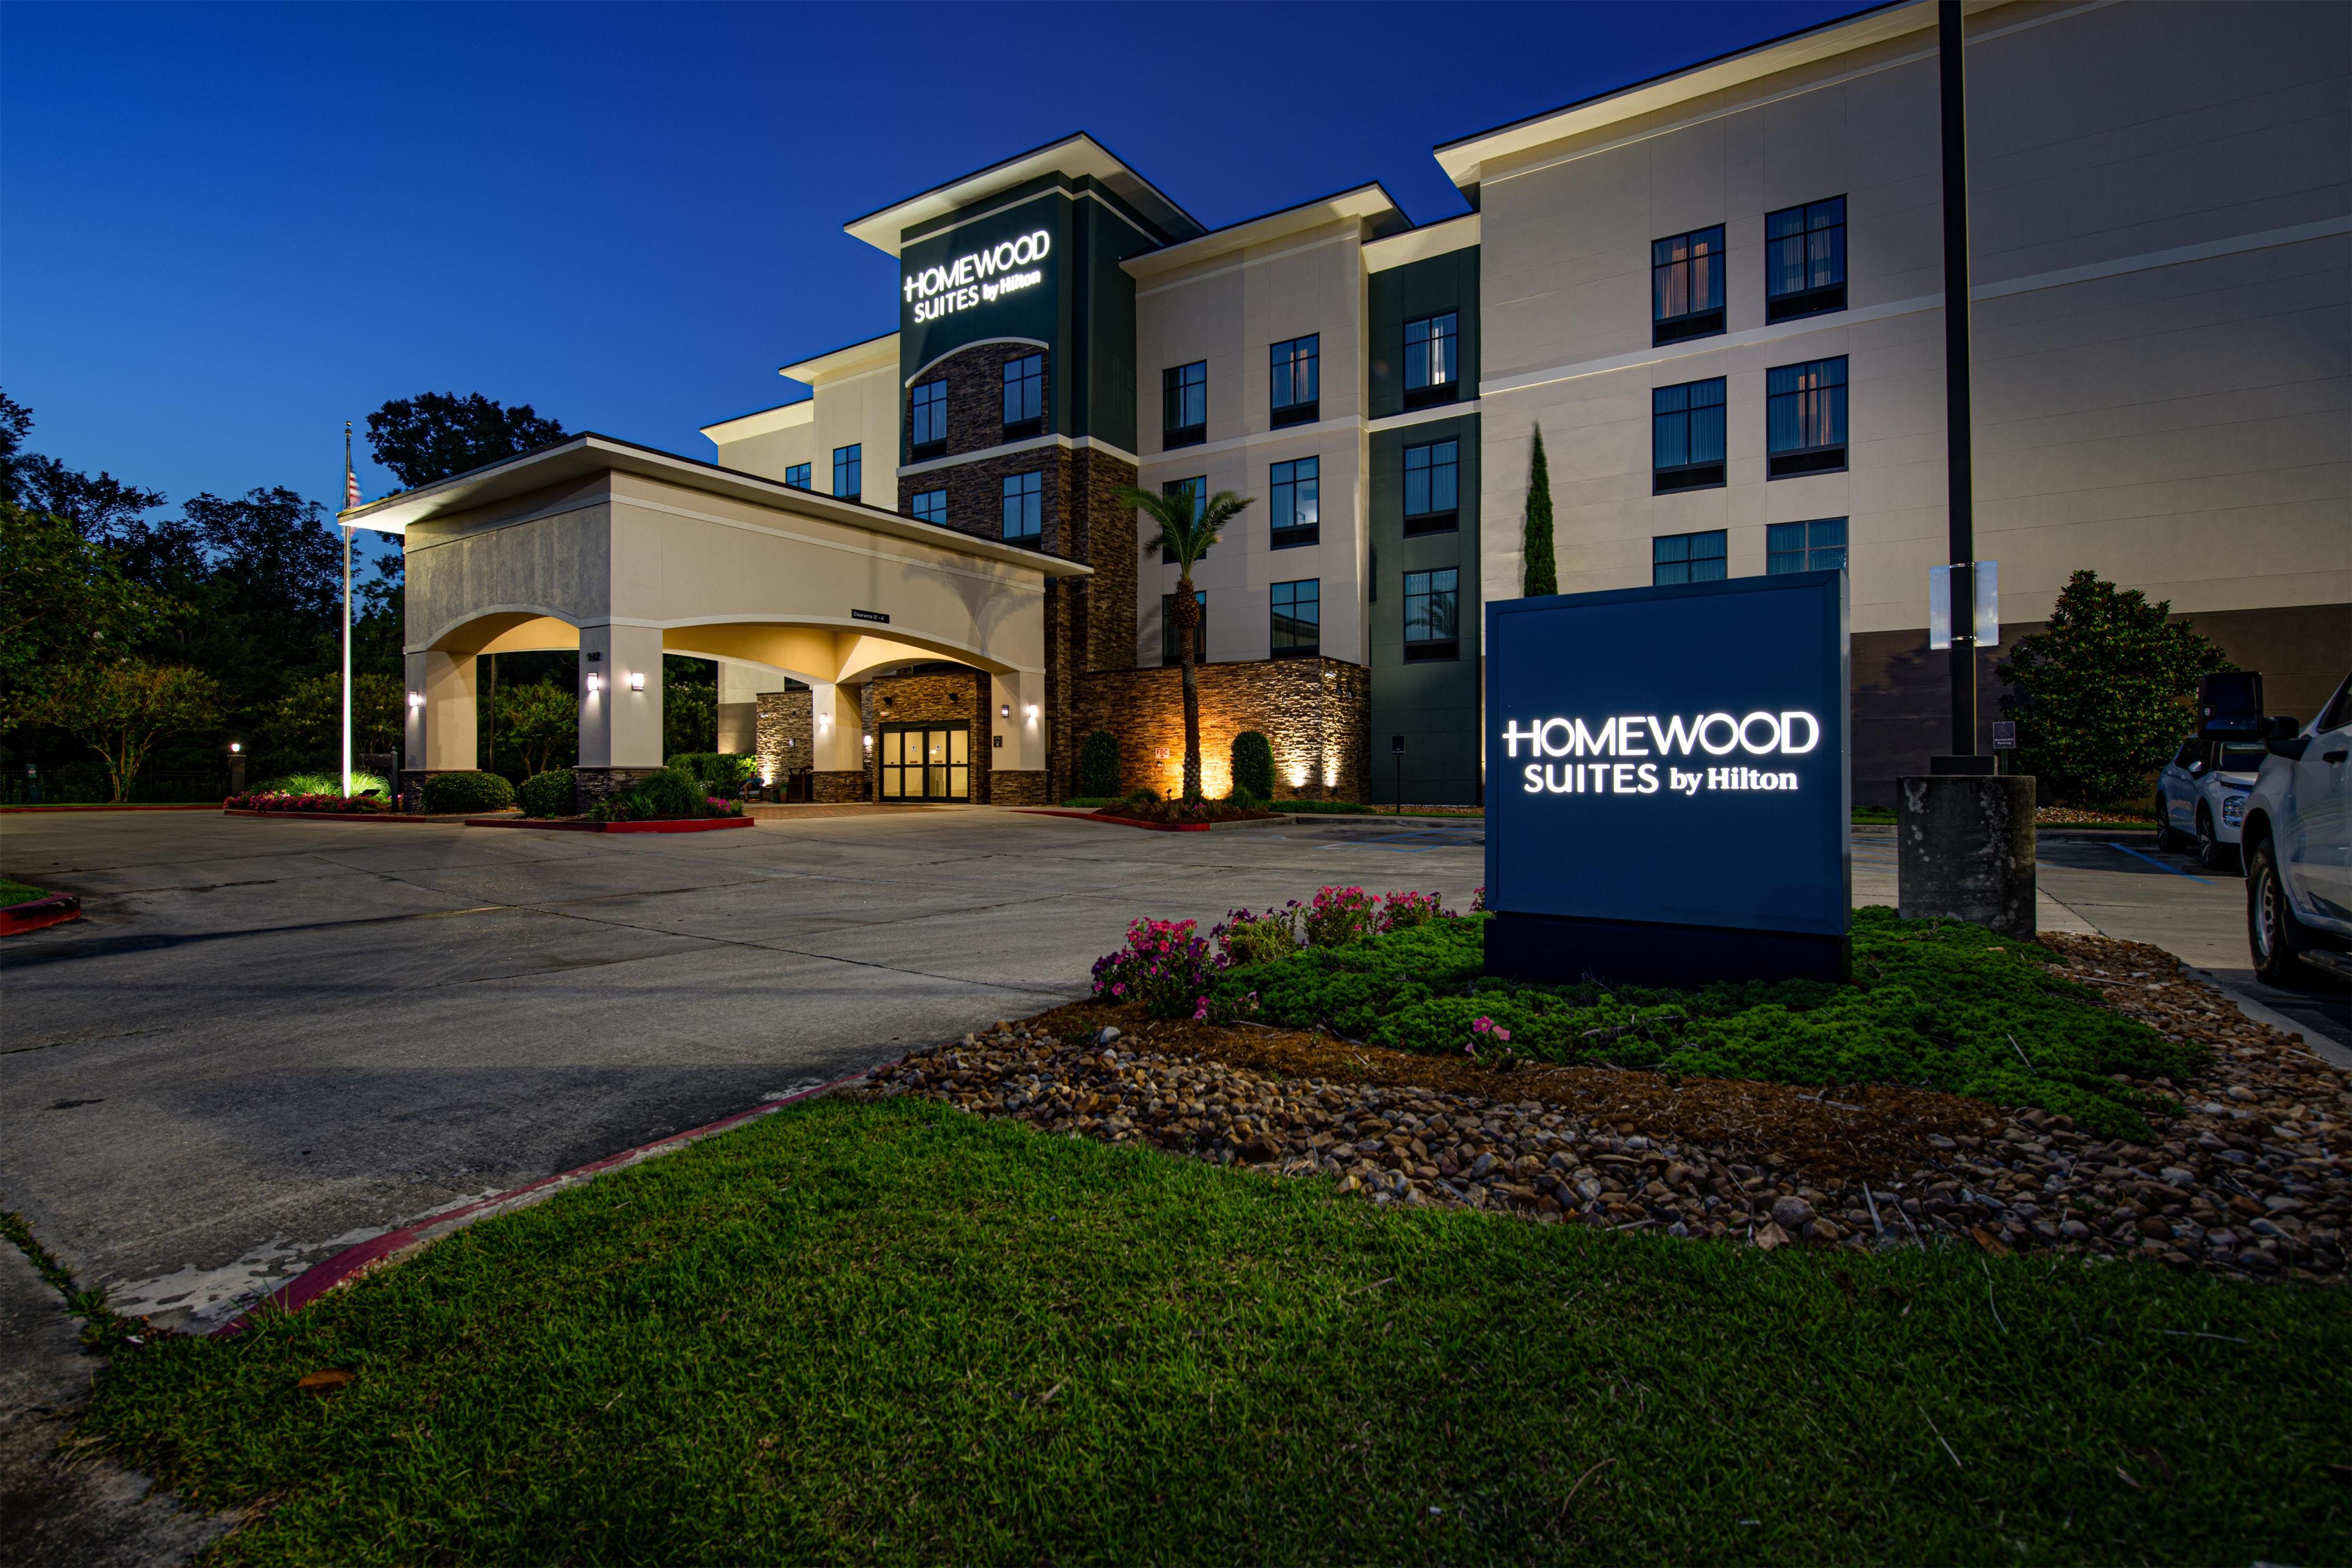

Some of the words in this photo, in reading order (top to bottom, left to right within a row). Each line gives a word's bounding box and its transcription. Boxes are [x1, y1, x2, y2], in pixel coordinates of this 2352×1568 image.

[904, 231, 1050, 302] HOMEWOOD
[915, 285, 979, 323] SUITES
[983, 284, 1000, 301] by
[1000, 271, 1041, 294] Hilton
[1502, 712, 1819, 757] HOMEWOOD
[1524, 764, 1659, 793] SUITES
[1670, 767, 1703, 795] by
[1707, 767, 1798, 790] Hilton
